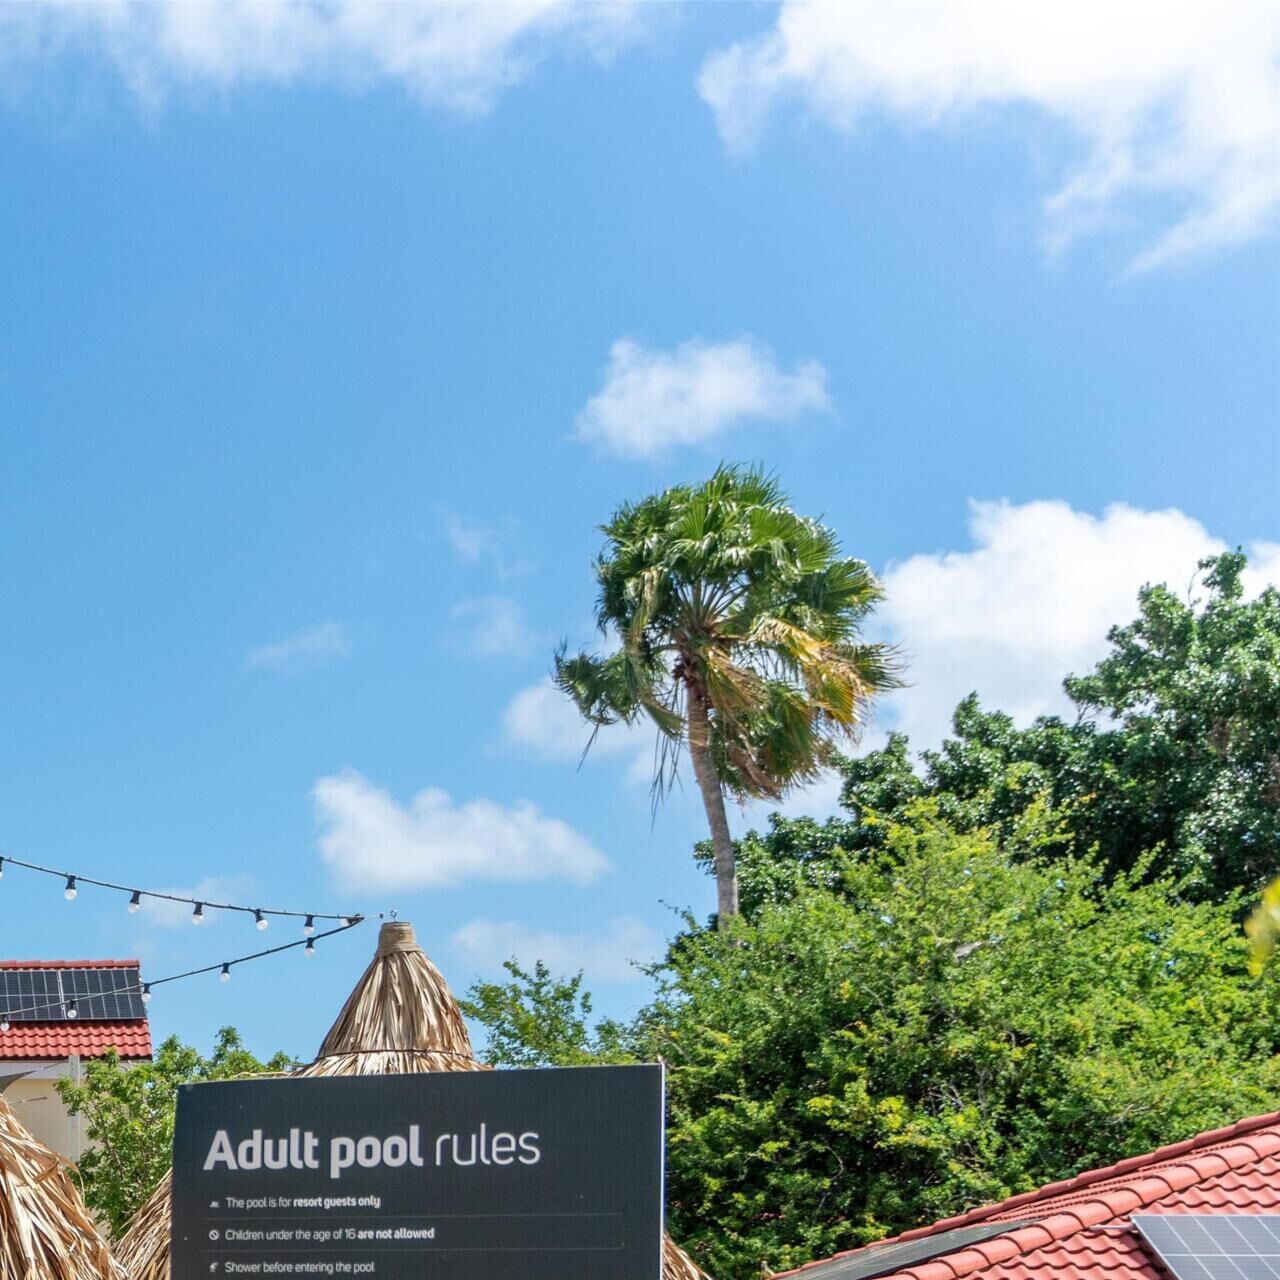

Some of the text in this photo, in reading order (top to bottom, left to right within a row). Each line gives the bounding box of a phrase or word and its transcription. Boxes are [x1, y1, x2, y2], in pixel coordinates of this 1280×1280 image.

[204, 1124, 540, 1178] Adult pool rules
[225, 1195, 381, 1210] The pool is for resort guests only
[225, 1227, 435, 1242] Children under the age of 16 are not allowed
[225, 1261, 375, 1275] Shower before entering the pool
